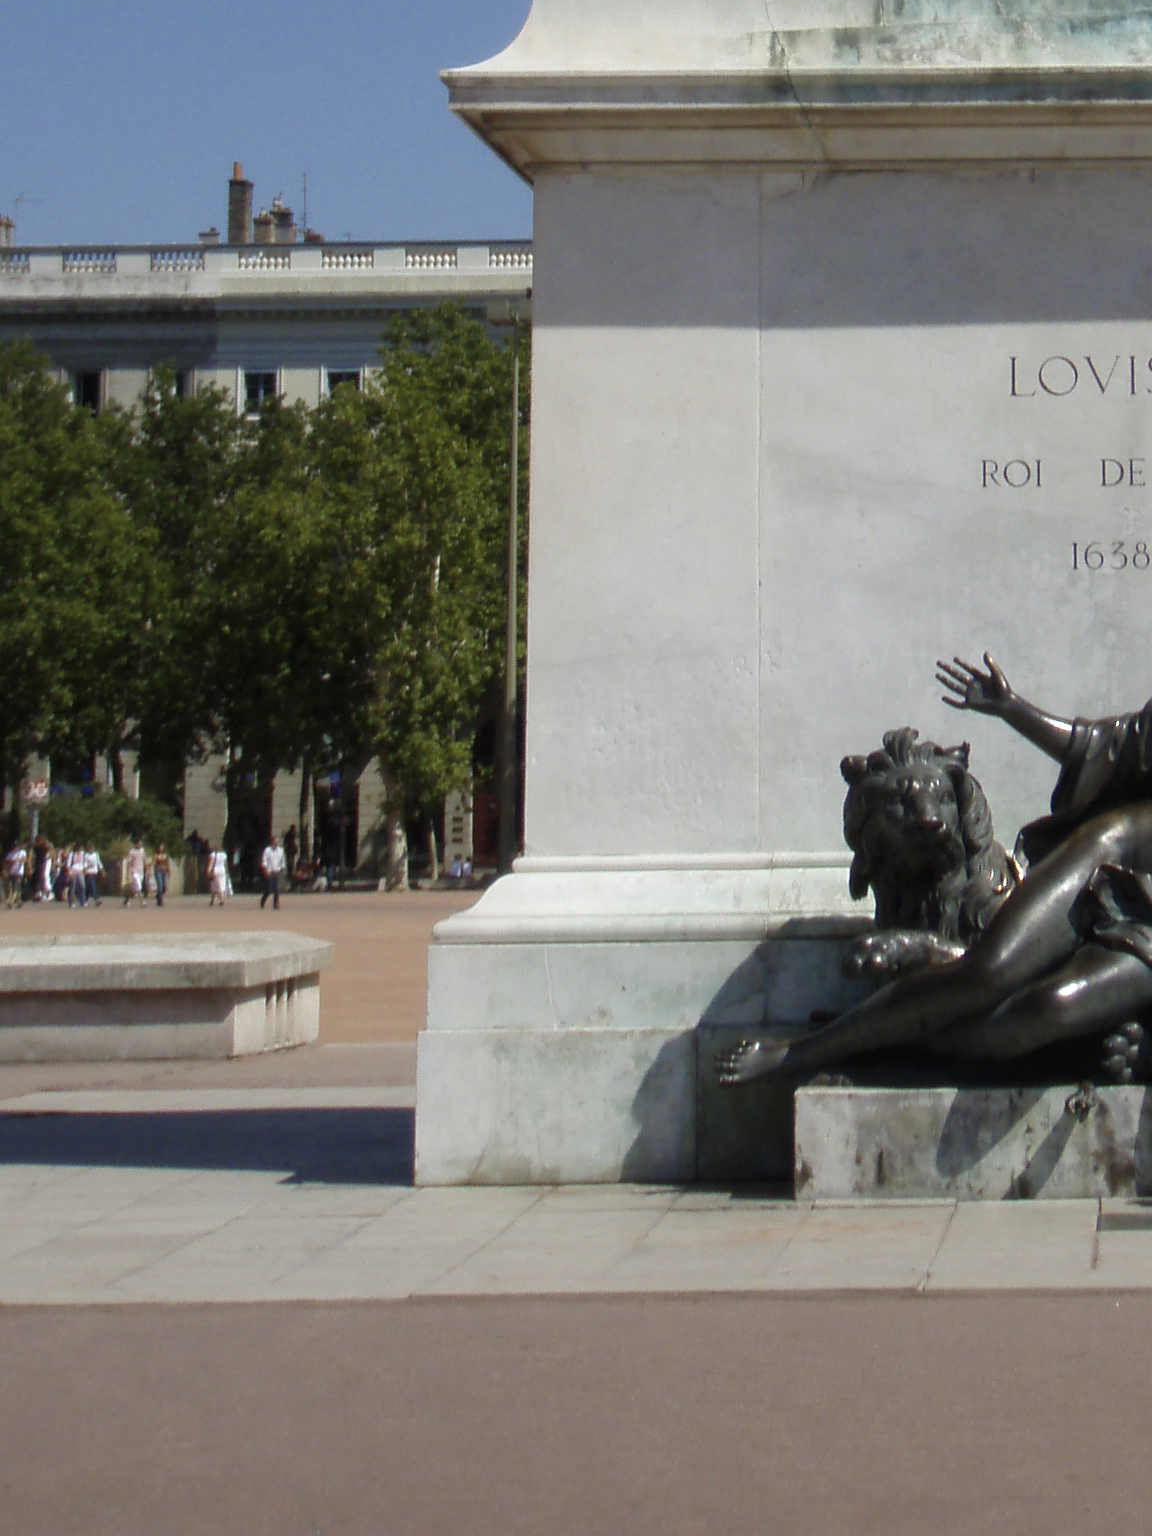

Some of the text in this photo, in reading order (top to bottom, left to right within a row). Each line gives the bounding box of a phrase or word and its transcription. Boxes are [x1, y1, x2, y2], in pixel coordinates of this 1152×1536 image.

[981, 459, 1042, 488] ROI
[1101, 457, 1147, 487] DE
[1072, 540, 1151, 571] 1638
